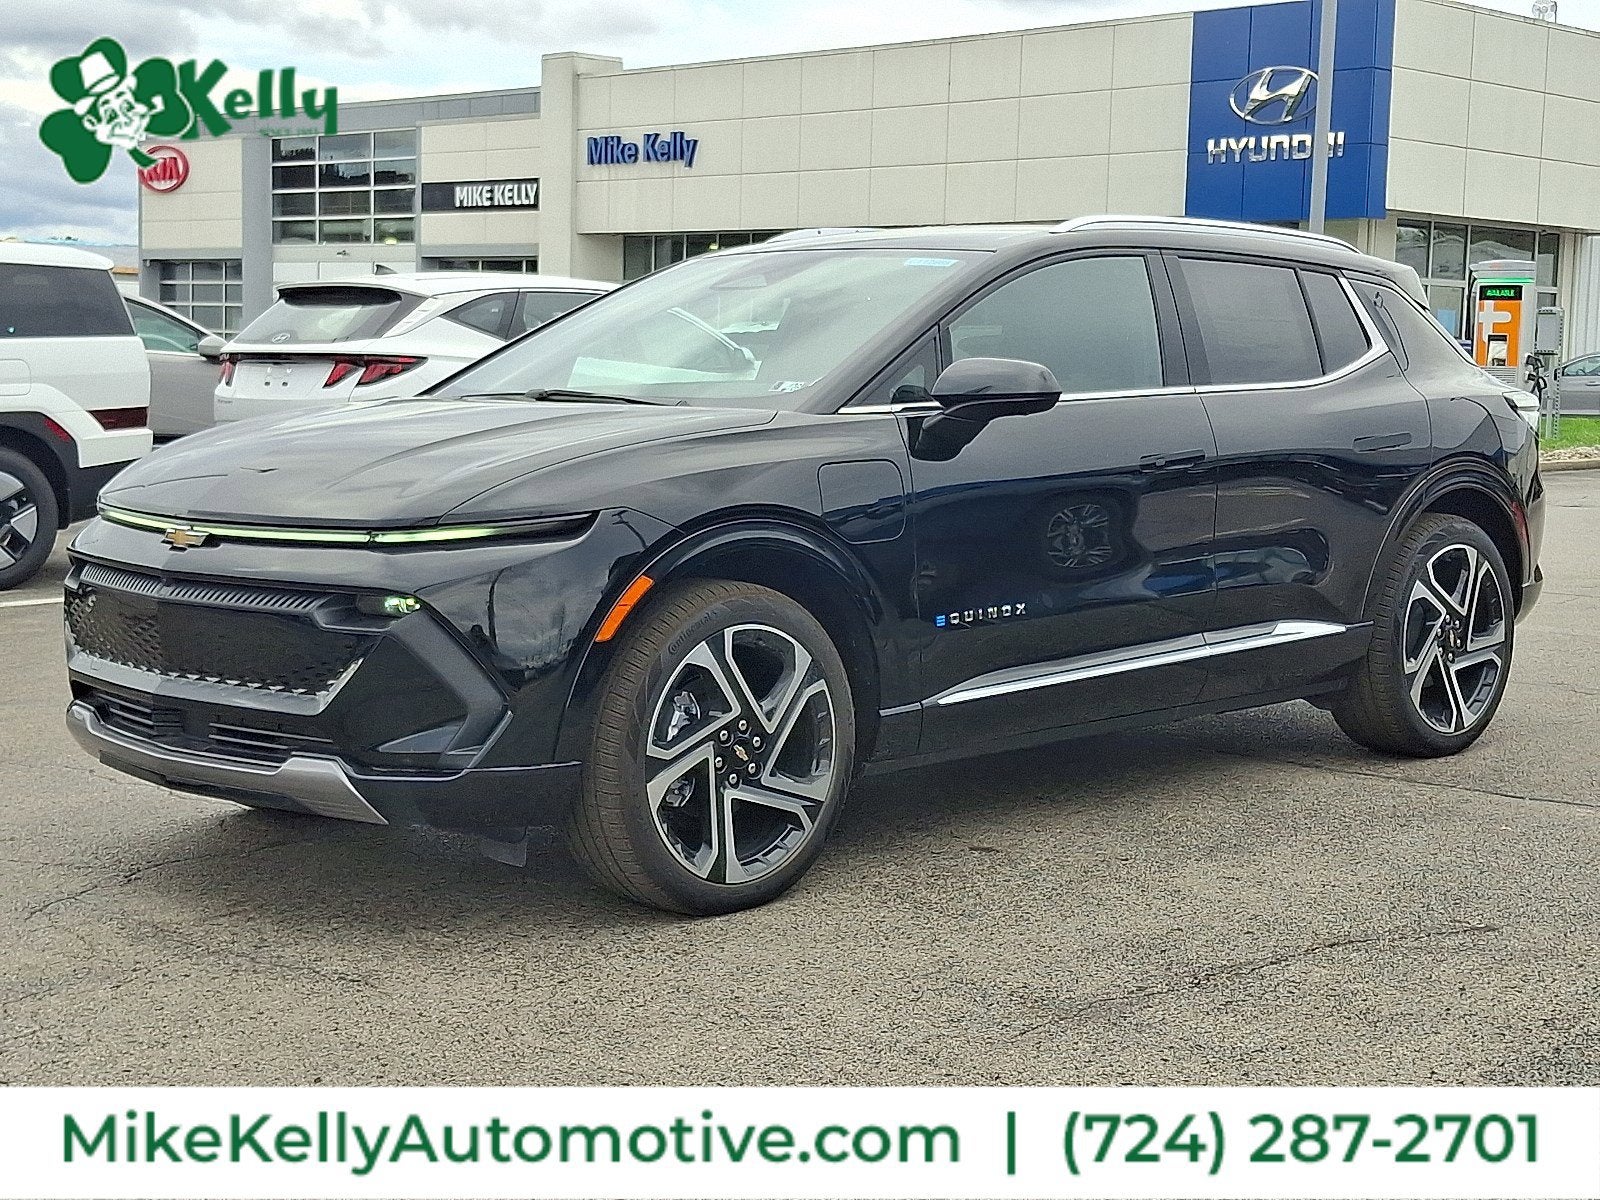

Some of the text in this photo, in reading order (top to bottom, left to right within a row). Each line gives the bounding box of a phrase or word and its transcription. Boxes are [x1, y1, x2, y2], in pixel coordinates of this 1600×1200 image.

[587, 131, 698, 168] Mike Kelly
[454, 183, 537, 207] MIKE KELLY
[936, 602, 1026, 627] EQUINOX
